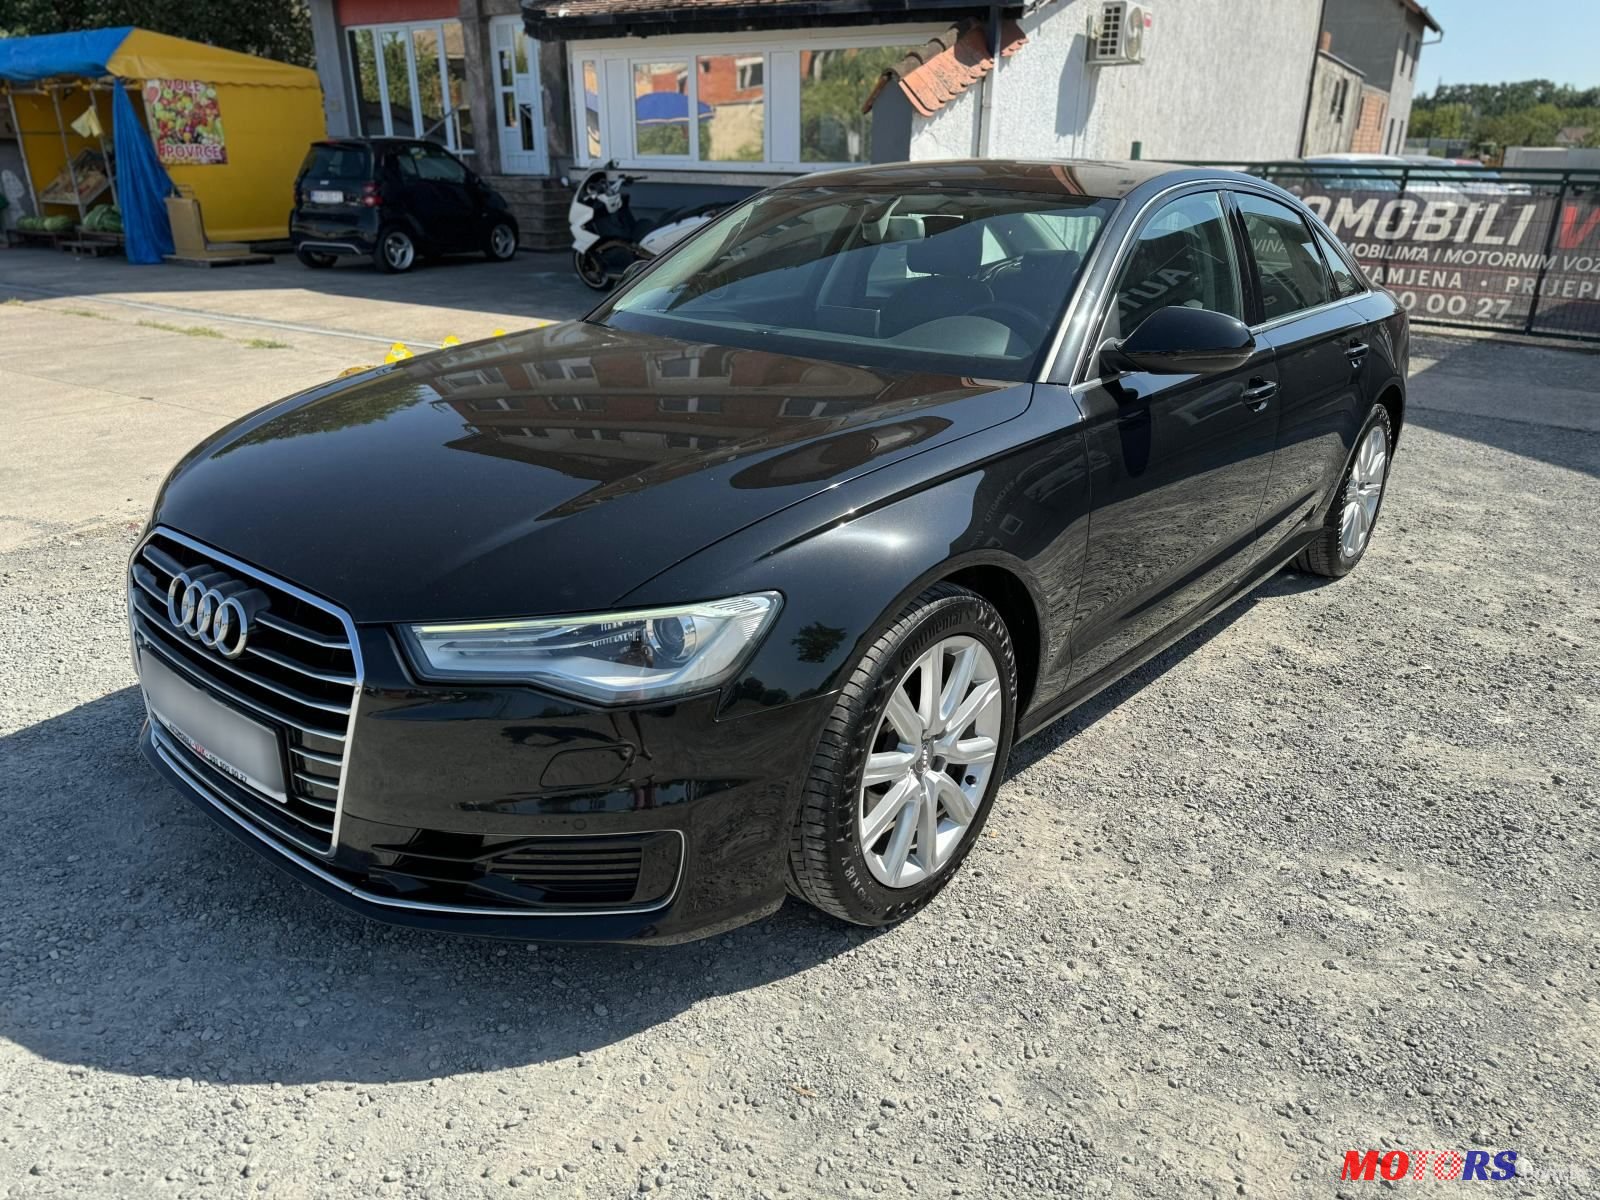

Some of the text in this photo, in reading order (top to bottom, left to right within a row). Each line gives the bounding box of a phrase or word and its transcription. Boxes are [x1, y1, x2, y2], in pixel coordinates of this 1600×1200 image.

[1433, 247, 1441, 263] I
[1443, 249, 1557, 270] MOTORNIM
[1426, 294, 1467, 315] 00
[1474, 298, 1512, 319] 27
